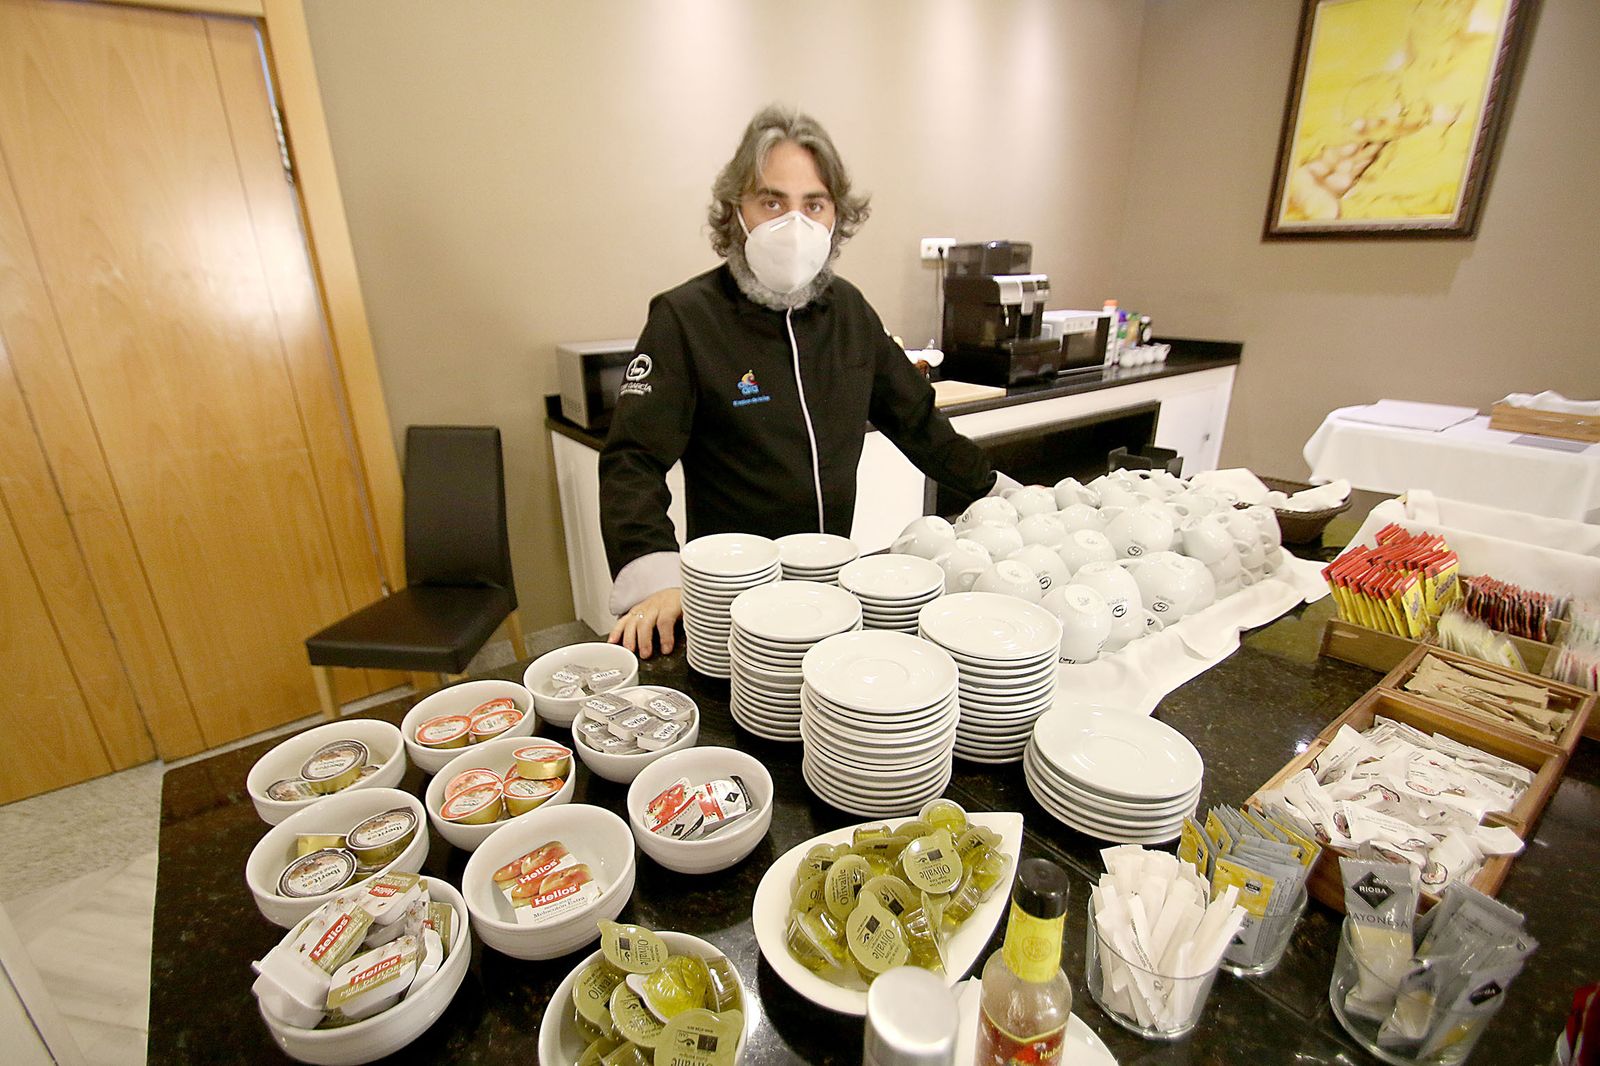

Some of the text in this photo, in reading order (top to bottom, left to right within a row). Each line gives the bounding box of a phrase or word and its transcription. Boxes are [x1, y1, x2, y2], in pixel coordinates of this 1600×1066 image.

[302, 868, 340, 888] Iberitos
[519, 860, 557, 884] Helios
[919, 864, 951, 881] Olivalle
[534, 885, 577, 906] Helios
[840, 868, 849, 906] Olivalle
[1359, 885, 1388, 895] RIOBA
[313, 917, 350, 958] Helios
[872, 929, 896, 960] Olivalle
[637, 939, 649, 965] Olivalle
[354, 957, 398, 984] Helios
[588, 977, 613, 1000] Olival
